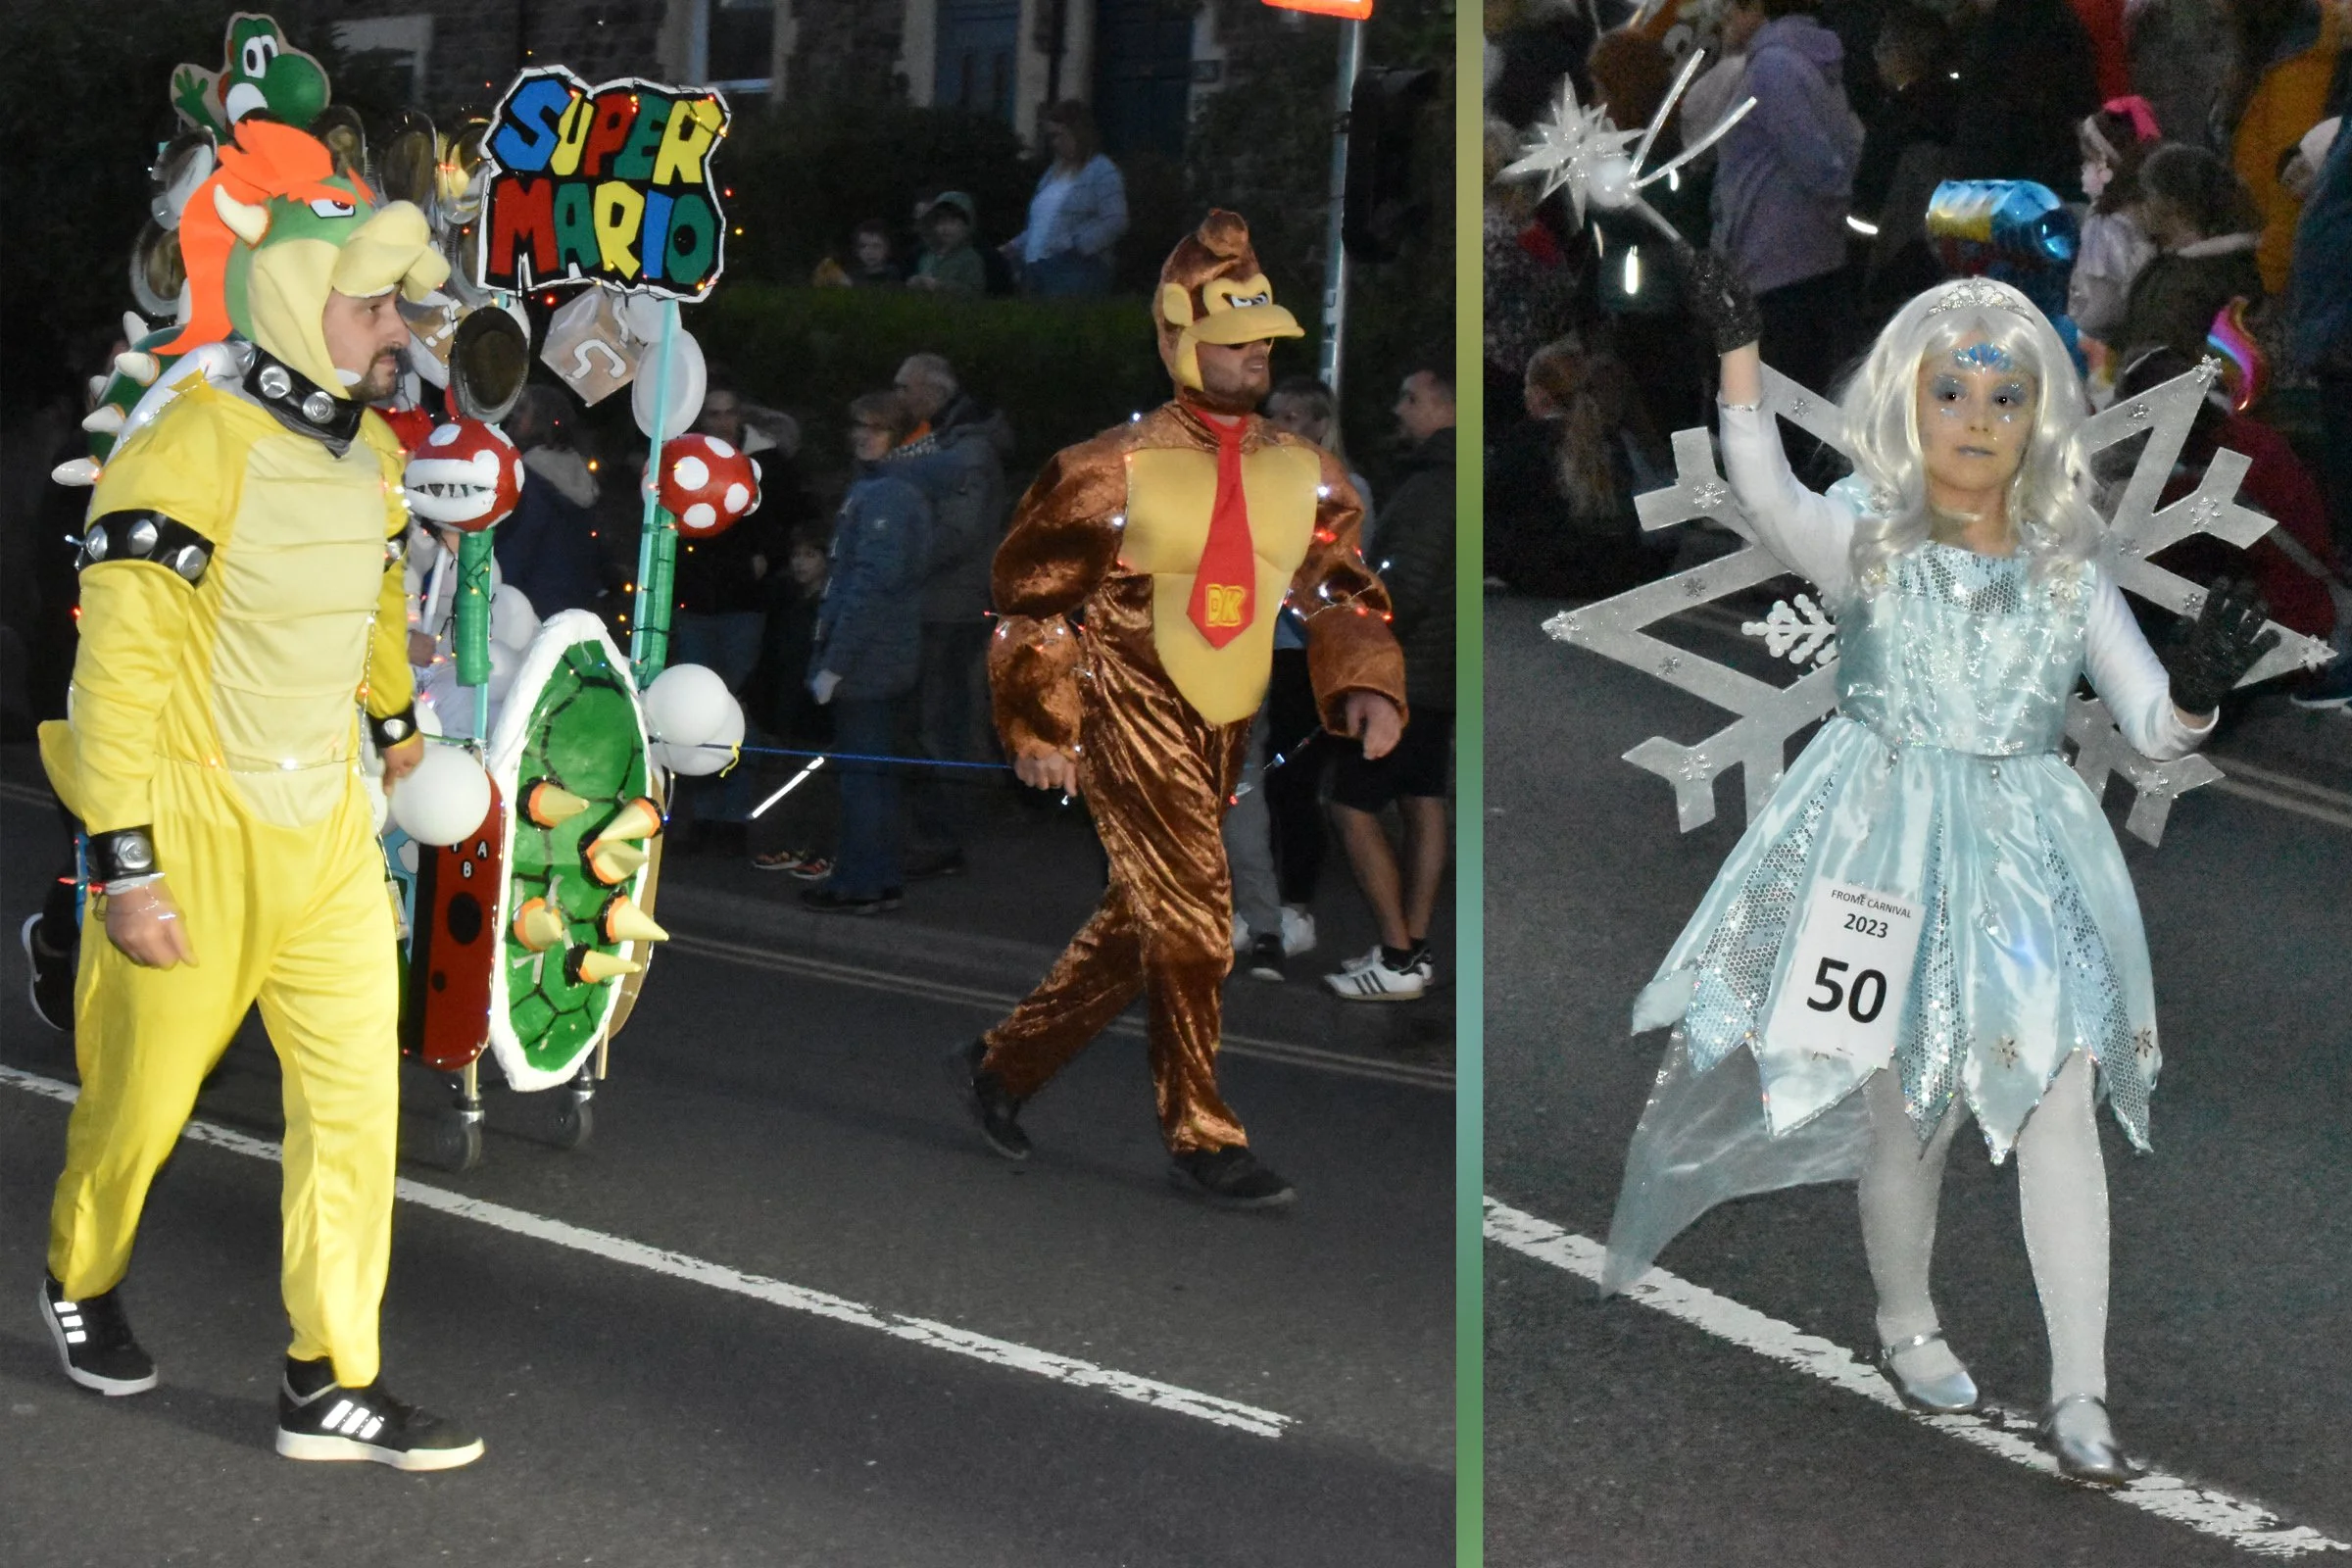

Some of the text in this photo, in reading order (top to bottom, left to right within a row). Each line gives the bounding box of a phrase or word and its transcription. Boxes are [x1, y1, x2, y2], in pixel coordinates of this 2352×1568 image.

[492, 78, 723, 186] SUPER
[490, 179, 715, 285] MARIO
[1205, 583, 1247, 627] DK
[477, 841, 487, 858] A
[463, 860, 472, 878] B
[1831, 889, 1912, 918] FROME CARNIVAL
[1843, 912, 1888, 939] 2023
[1806, 956, 1887, 1024] 50
